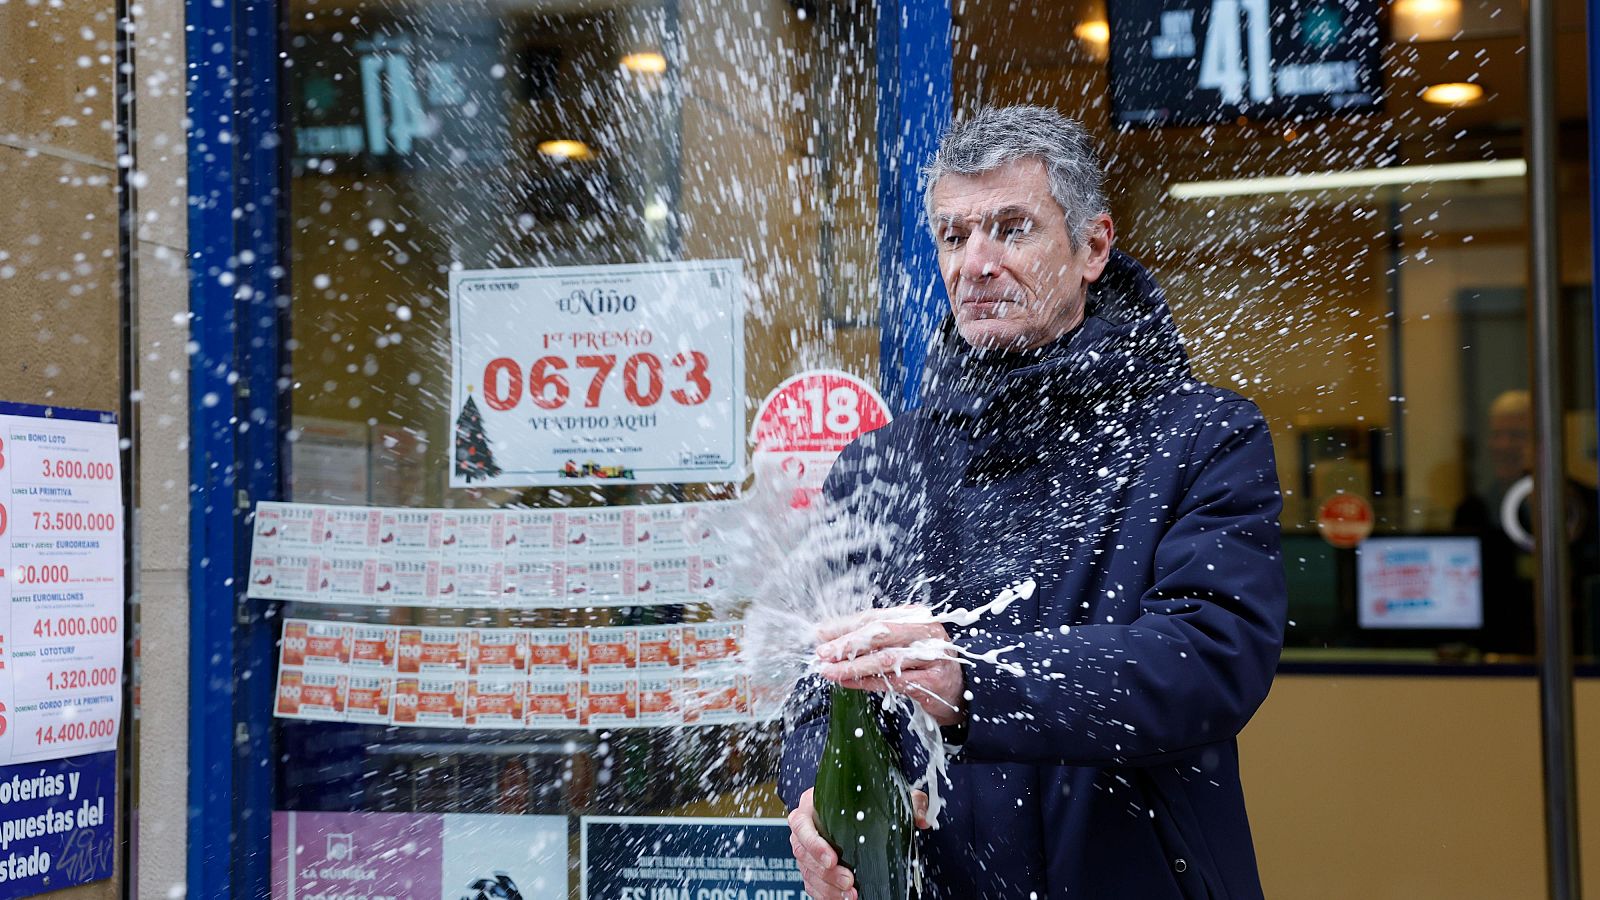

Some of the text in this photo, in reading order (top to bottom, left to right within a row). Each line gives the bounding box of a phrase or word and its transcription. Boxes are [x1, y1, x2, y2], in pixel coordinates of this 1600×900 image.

[570, 287, 636, 315] Niño
[569, 328, 653, 350] PREMIO
[483, 350, 711, 411] 06703
[782, 386, 860, 434] +18
[528, 414, 609, 431] VENDIDO
[28, 433, 47, 443] BONO
[48, 435, 66, 444] LOTO
[42, 459, 114, 480] 3.600.000
[29, 487, 38, 495] LA
[39, 488, 72, 496] PRIMITIVA
[32, 511, 115, 531] 73.500.000
[56, 540, 99, 549] EURODREAMS
[33, 592, 84, 603] EUROMILLONES
[33, 616, 117, 638] 41.000.000
[12, 646, 76, 658] DOMINGO LOTOTURF
[46, 667, 117, 691] 1.320.000
[15, 704, 38, 713] DOMINGO
[39, 700, 62, 710] GORDO
[83, 695, 114, 705] PRIMITIVA
[36, 718, 114, 746] 14.400.000
[0, 769, 80, 804] oterías y
[77, 796, 104, 829] del
[0, 846, 51, 882] stado
